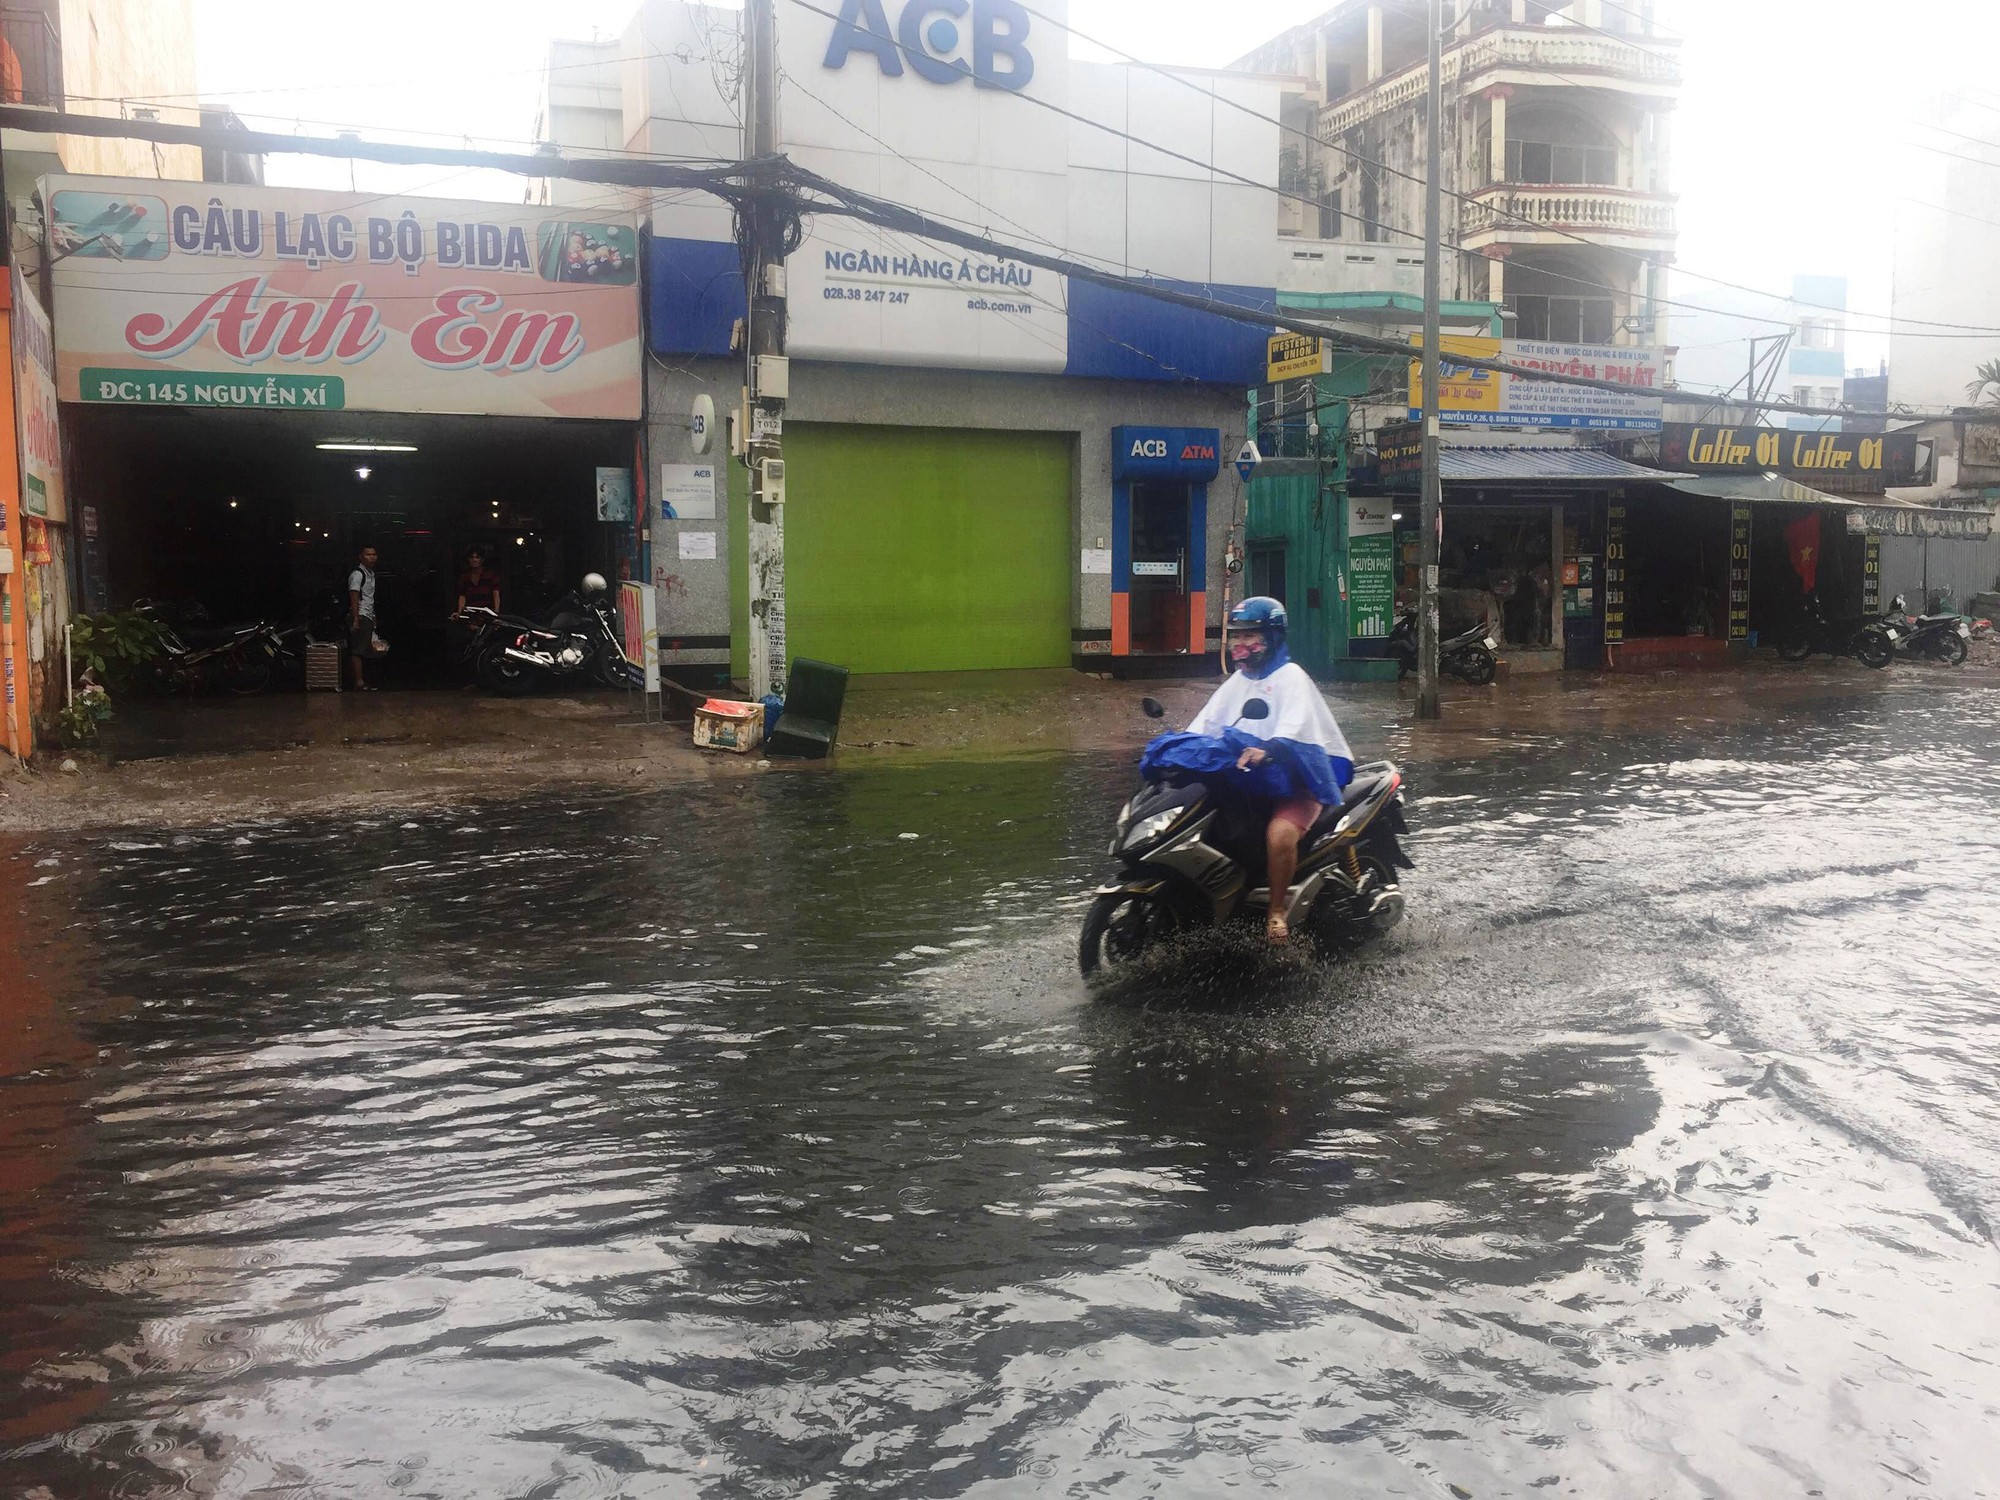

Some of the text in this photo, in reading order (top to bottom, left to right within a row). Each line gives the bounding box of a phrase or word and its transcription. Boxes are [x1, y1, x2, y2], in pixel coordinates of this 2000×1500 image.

[822, 0, 1035, 91] ACB
[173, 197, 534, 275] CÂU LẠC BỘ BIDA
[825, 250, 1032, 287] NGÂN HÀNG Á CHÂU
[823, 286, 910, 304] 028.38 247 247
[967, 297, 1032, 315] acb.com.vn
[124, 277, 386, 366] Anh
[410, 286, 586, 373] Em
[1271, 335, 1313, 353] WESTERN
[1283, 344, 1312, 361] UNION
[1517, 343, 1535, 354] THIẾT
[1604, 361, 1656, 387] PHÁT
[99, 374, 328, 406] ĐC: 145 NGUYỄN XÍ
[1131, 439, 1215, 460] ACB ATM
[1380, 442, 1423, 460] NỘI THẤ
[1688, 427, 1883, 470] Coffee 01 Coffee 01
[694, 470, 711, 478] ACB
[1608, 543, 1625, 560] 01
[1733, 543, 1748, 560] 01
[1866, 561, 1878, 573] 01
